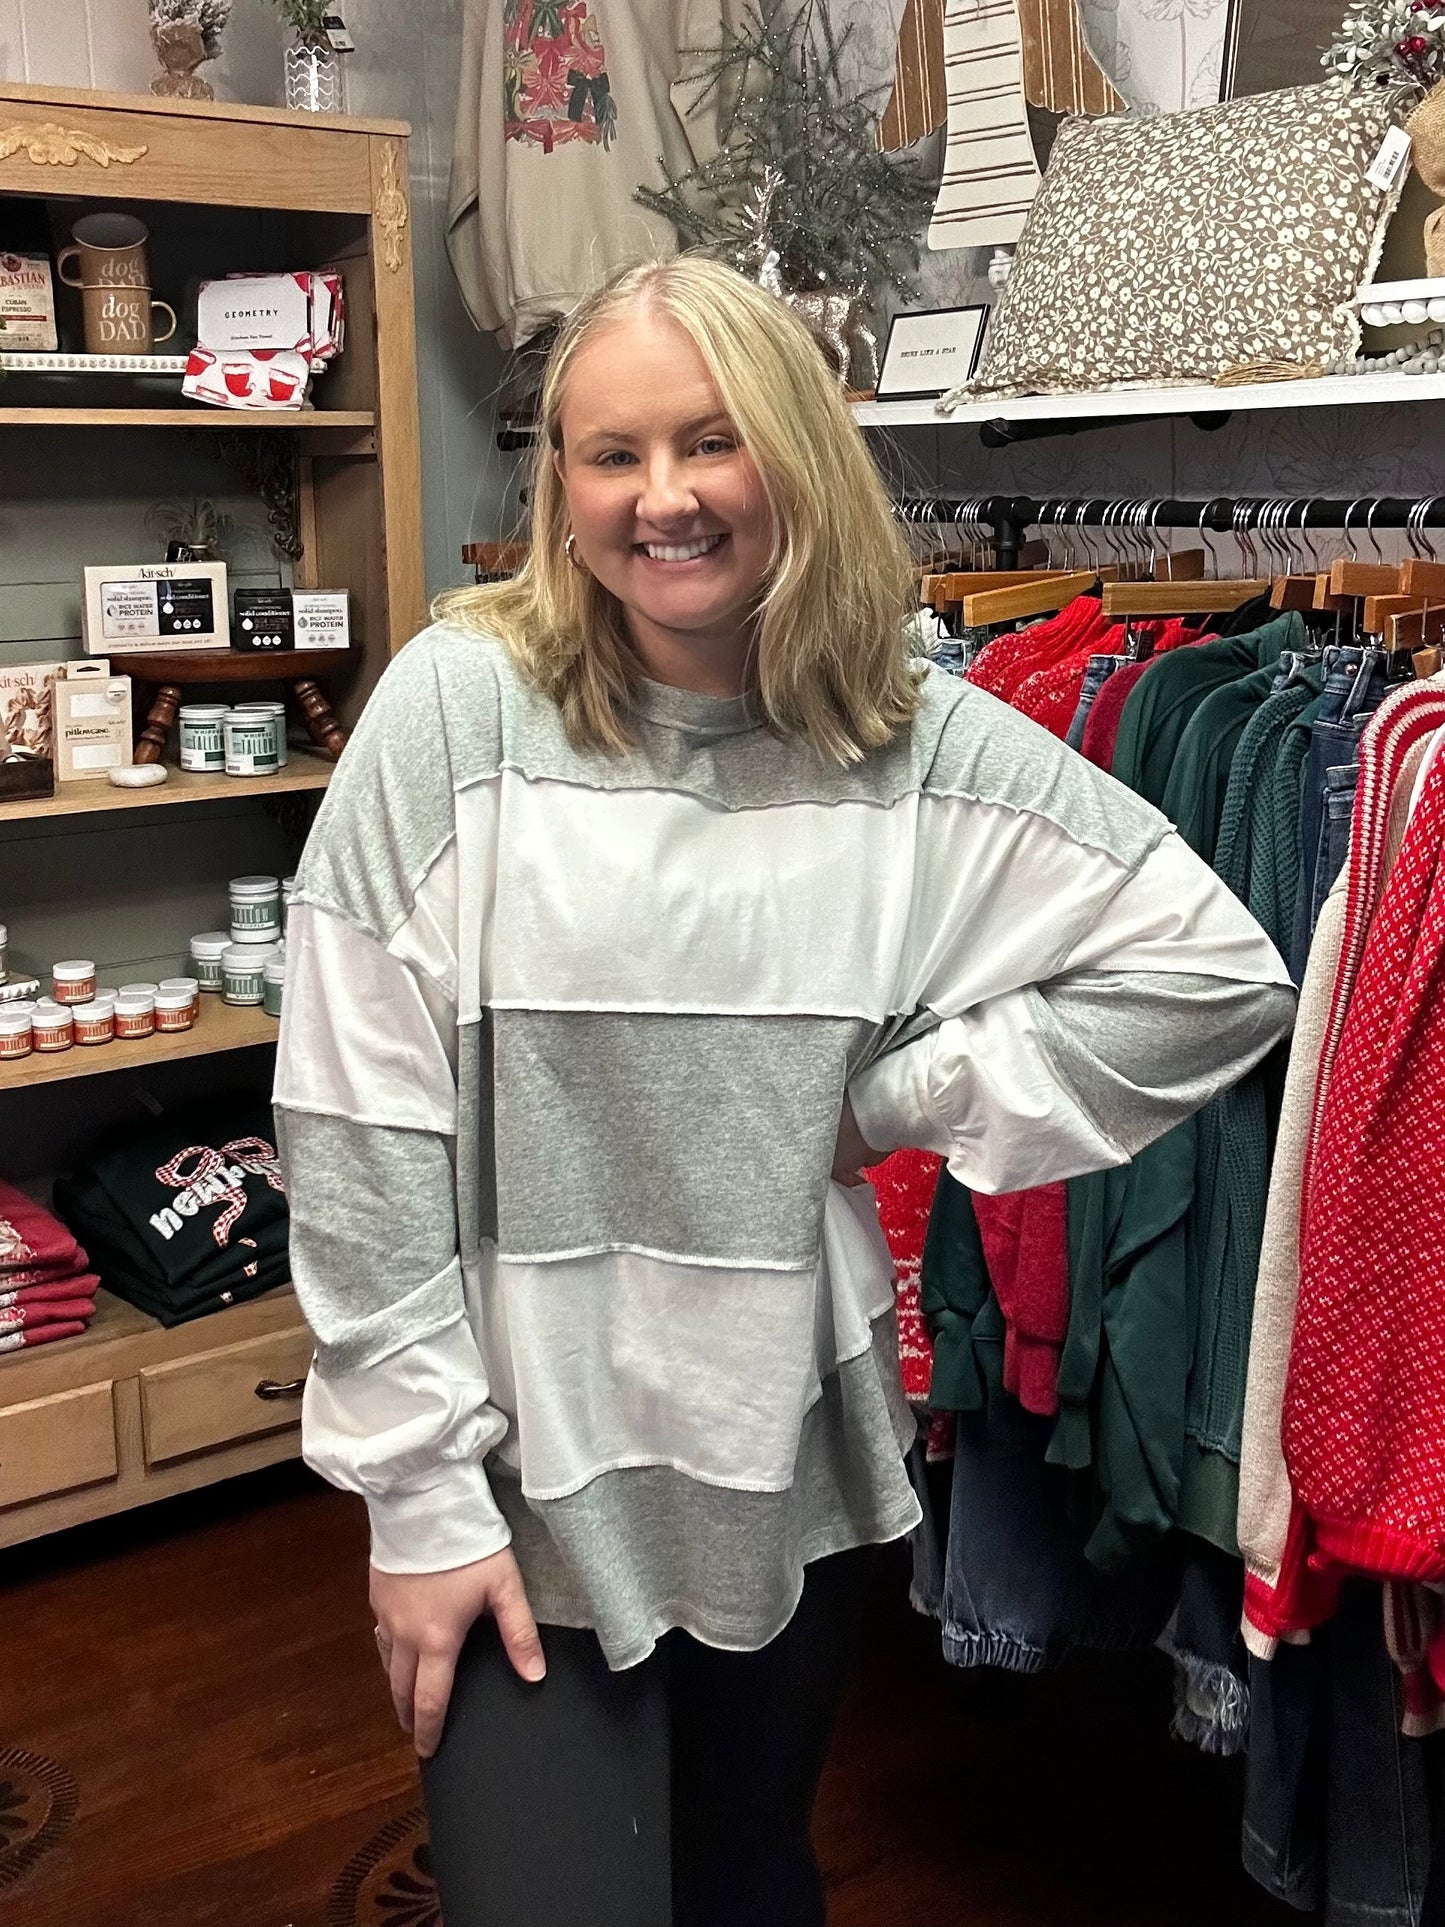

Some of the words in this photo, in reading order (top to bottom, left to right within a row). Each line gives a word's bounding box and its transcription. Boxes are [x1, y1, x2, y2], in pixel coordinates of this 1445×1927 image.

[101, 293, 140, 324] dog
[224, 309, 279, 319] GEOMETRY
[99, 319, 146, 341] DAD
